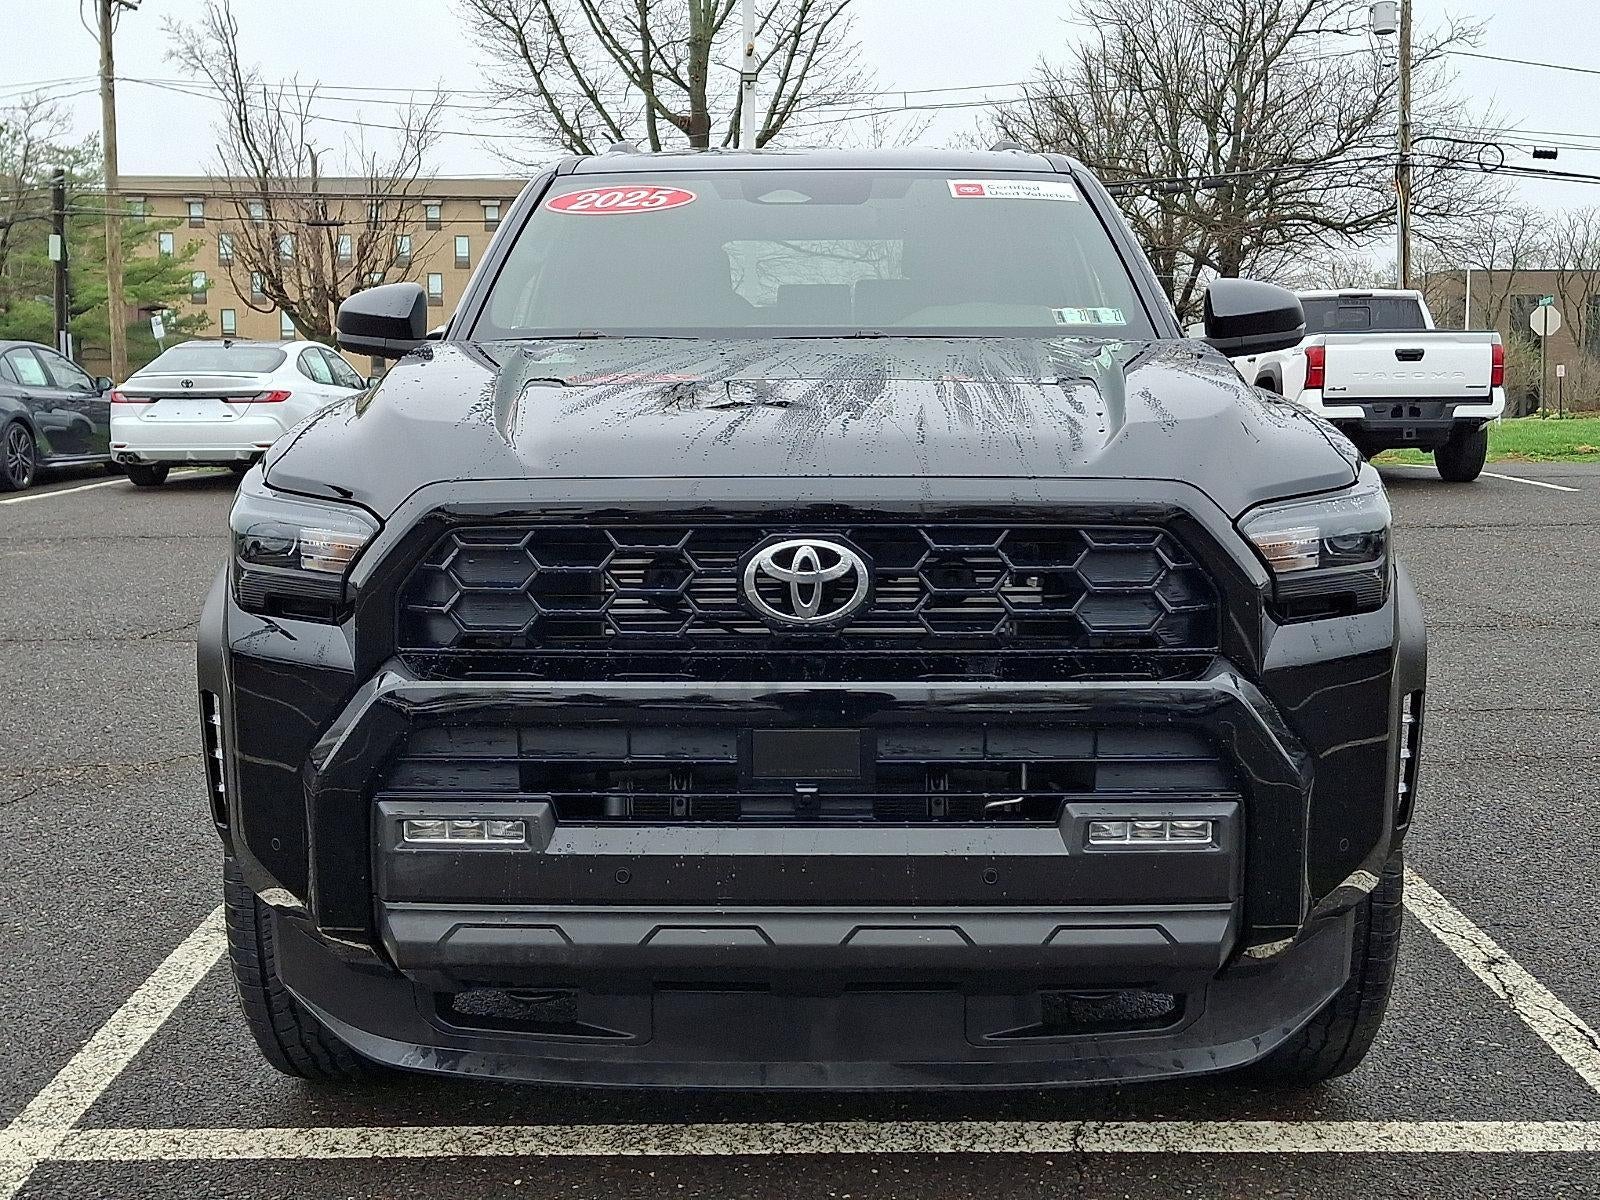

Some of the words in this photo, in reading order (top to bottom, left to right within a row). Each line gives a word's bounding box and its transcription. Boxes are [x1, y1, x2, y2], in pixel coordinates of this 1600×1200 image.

[1023, 191, 1072, 199] Vehicles
[567, 190, 676, 211] 2025
[1353, 371, 1465, 380] TACOMA
